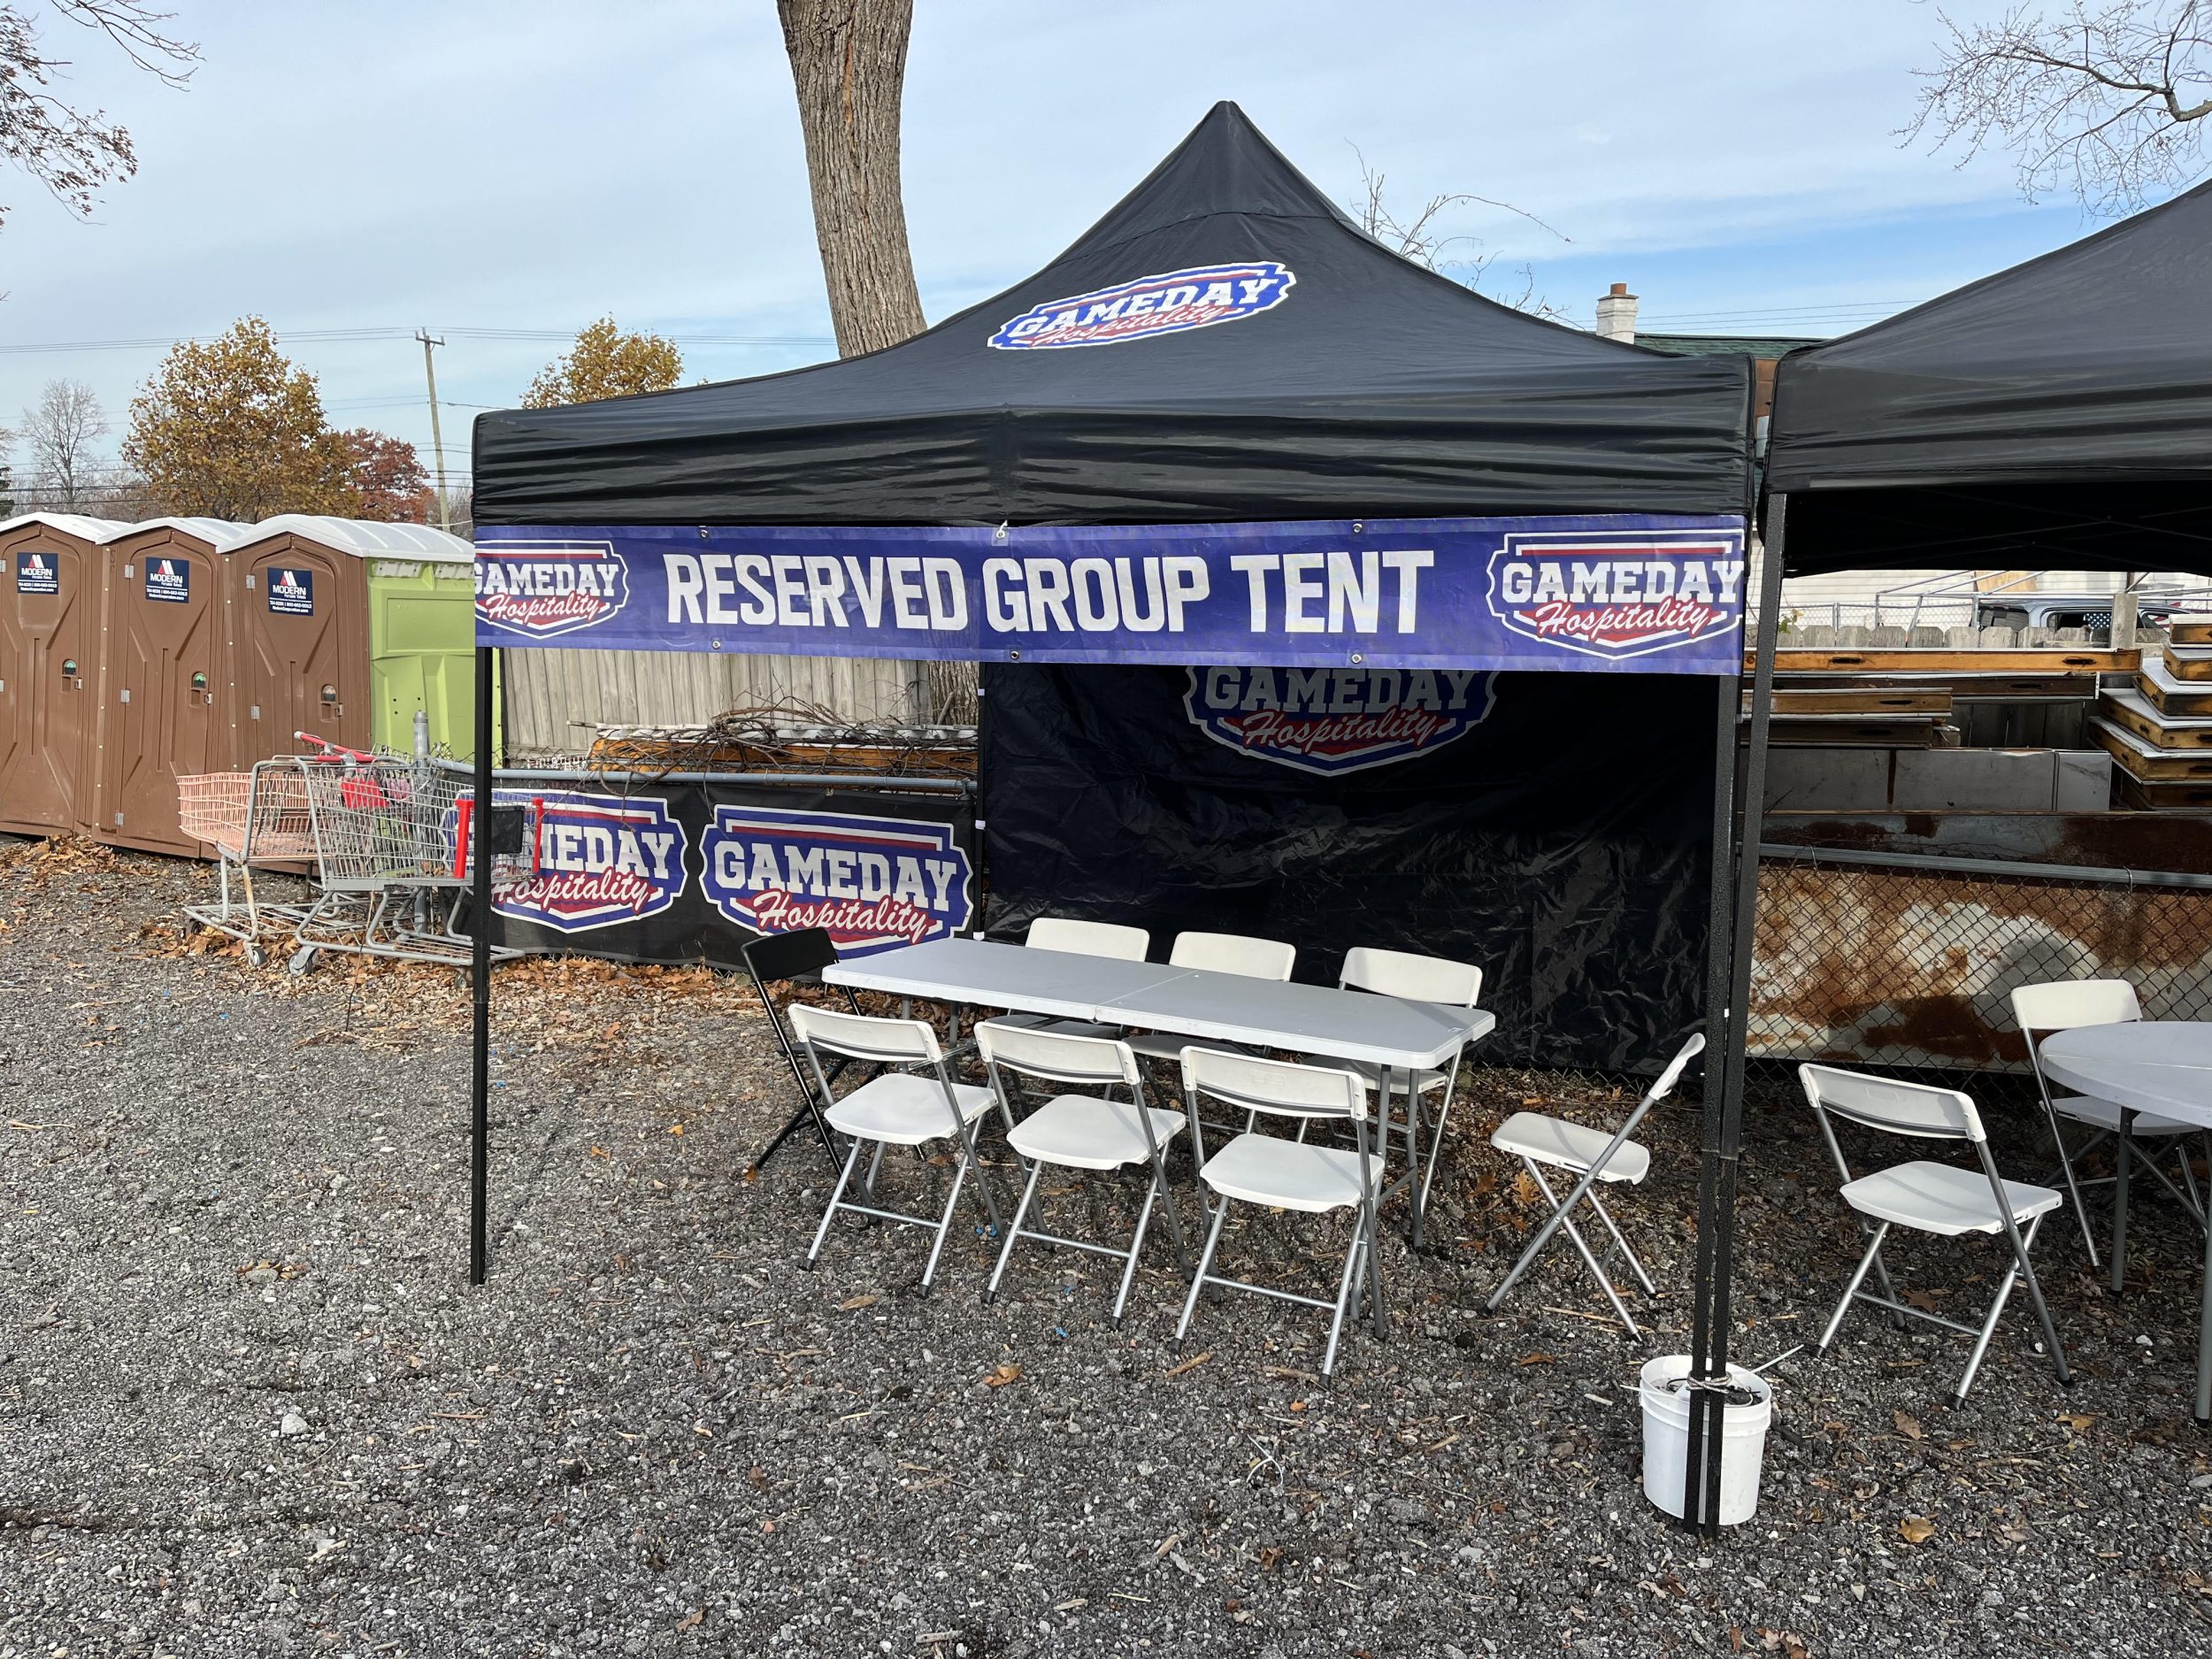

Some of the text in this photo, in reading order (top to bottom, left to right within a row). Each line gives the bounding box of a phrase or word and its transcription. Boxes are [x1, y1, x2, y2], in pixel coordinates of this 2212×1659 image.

[1007, 279, 1279, 337] GAMEDAY
[1033, 304, 1225, 346] Hospitality
[21, 567, 52, 576] MODERN
[150, 573, 182, 583] MODERN
[273, 585, 306, 595] MODERN
[663, 549, 1434, 634] RESERVED GROUP TENT
[1502, 560, 1744, 603] GAMEDAY
[486, 592, 600, 623] Hospitality
[1535, 597, 1709, 639] Hospitality
[1204, 667, 1479, 713] GAMEDAY
[1242, 707, 1437, 752] Hospitality
[714, 840, 957, 912] GAMEDAY
[753, 891, 927, 944] Hospitality
